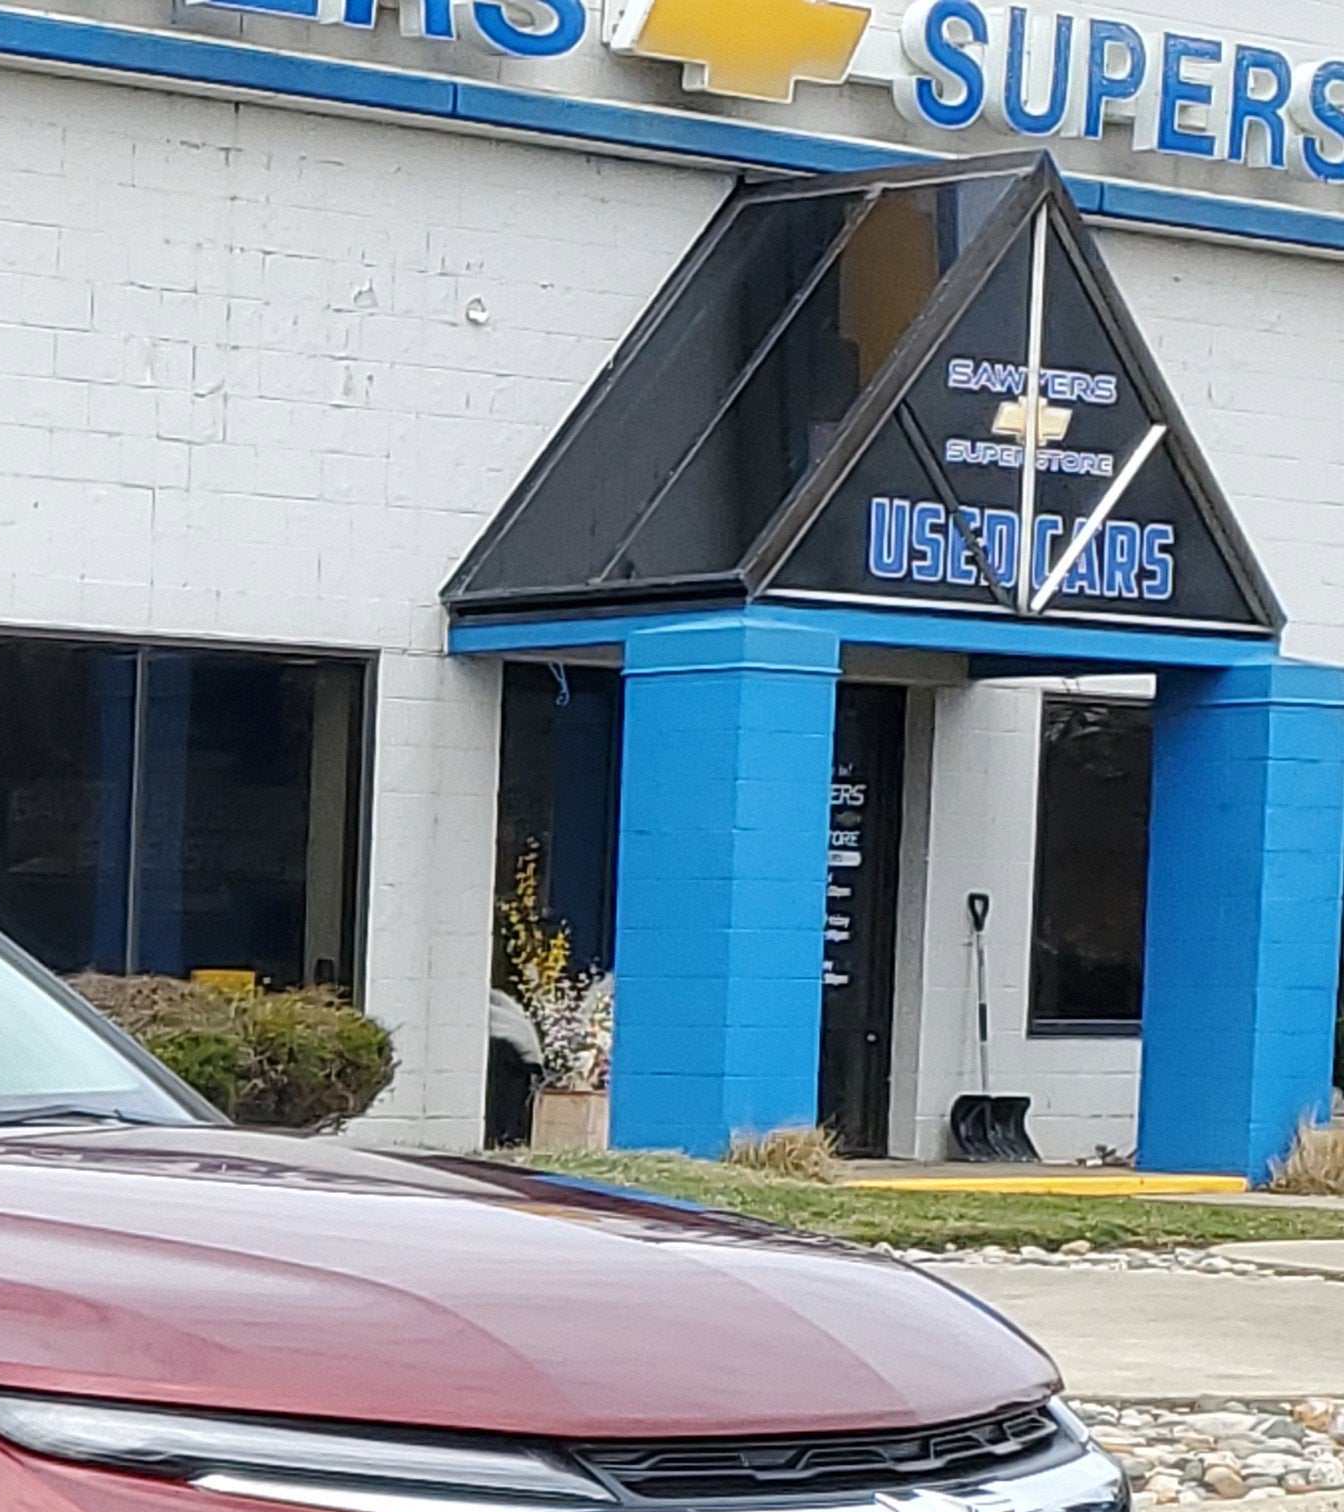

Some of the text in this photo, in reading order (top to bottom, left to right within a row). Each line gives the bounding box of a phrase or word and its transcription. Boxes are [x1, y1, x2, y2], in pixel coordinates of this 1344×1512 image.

[948, 358, 1117, 404] SAWERS
[869, 497, 1175, 600] USED CARS
